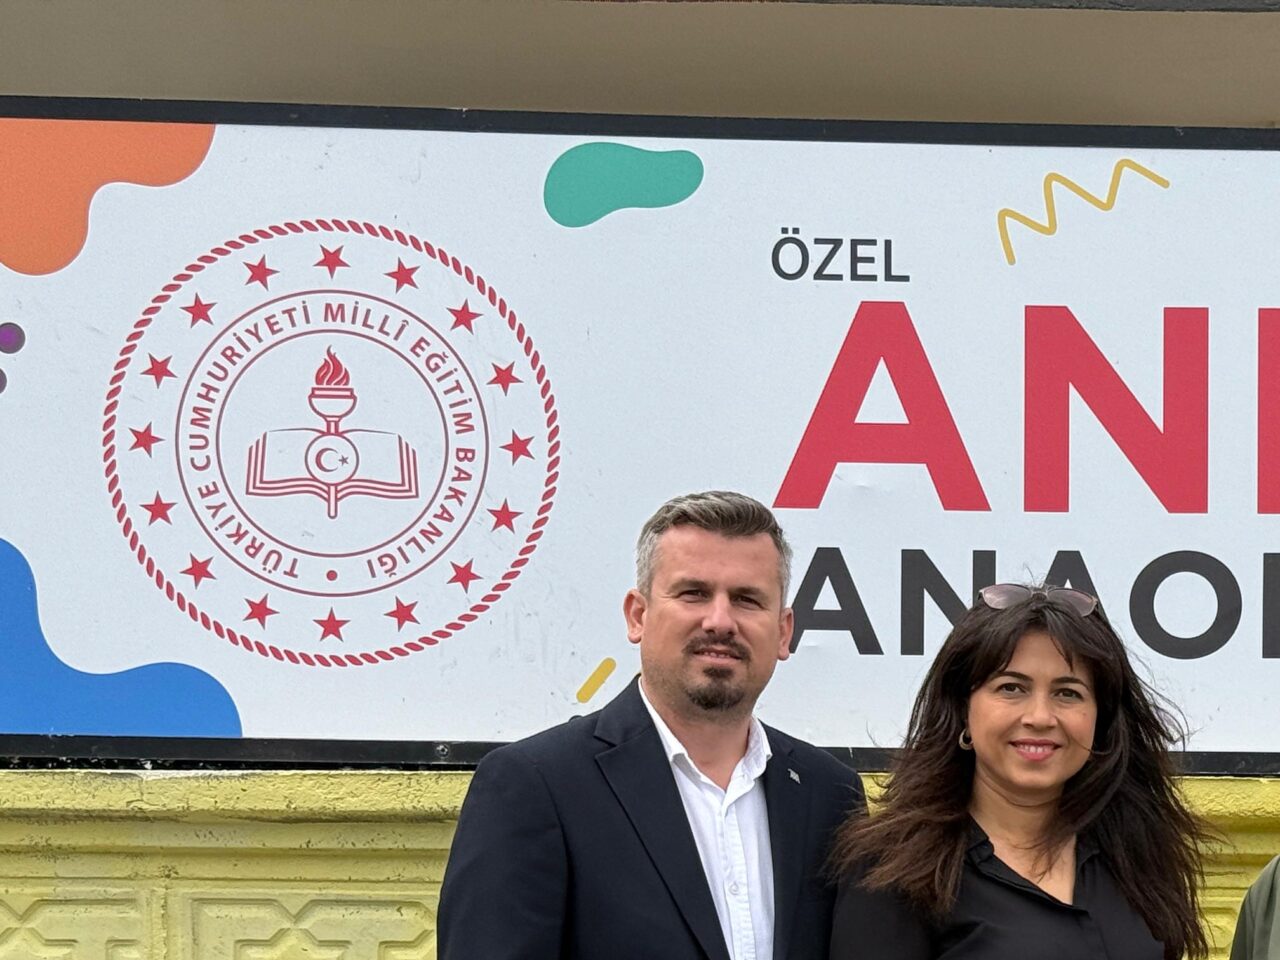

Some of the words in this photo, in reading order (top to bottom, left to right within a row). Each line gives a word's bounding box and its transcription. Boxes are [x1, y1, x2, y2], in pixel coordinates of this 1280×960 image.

[771, 227, 910, 283] ÖZEL
[189, 299, 313, 471] CUMHURİYETİ
[409, 336, 476, 436] EĞİTİM
[197, 481, 299, 579] TÜRKİYE
[366, 446, 476, 579] BAKANLIĞI
